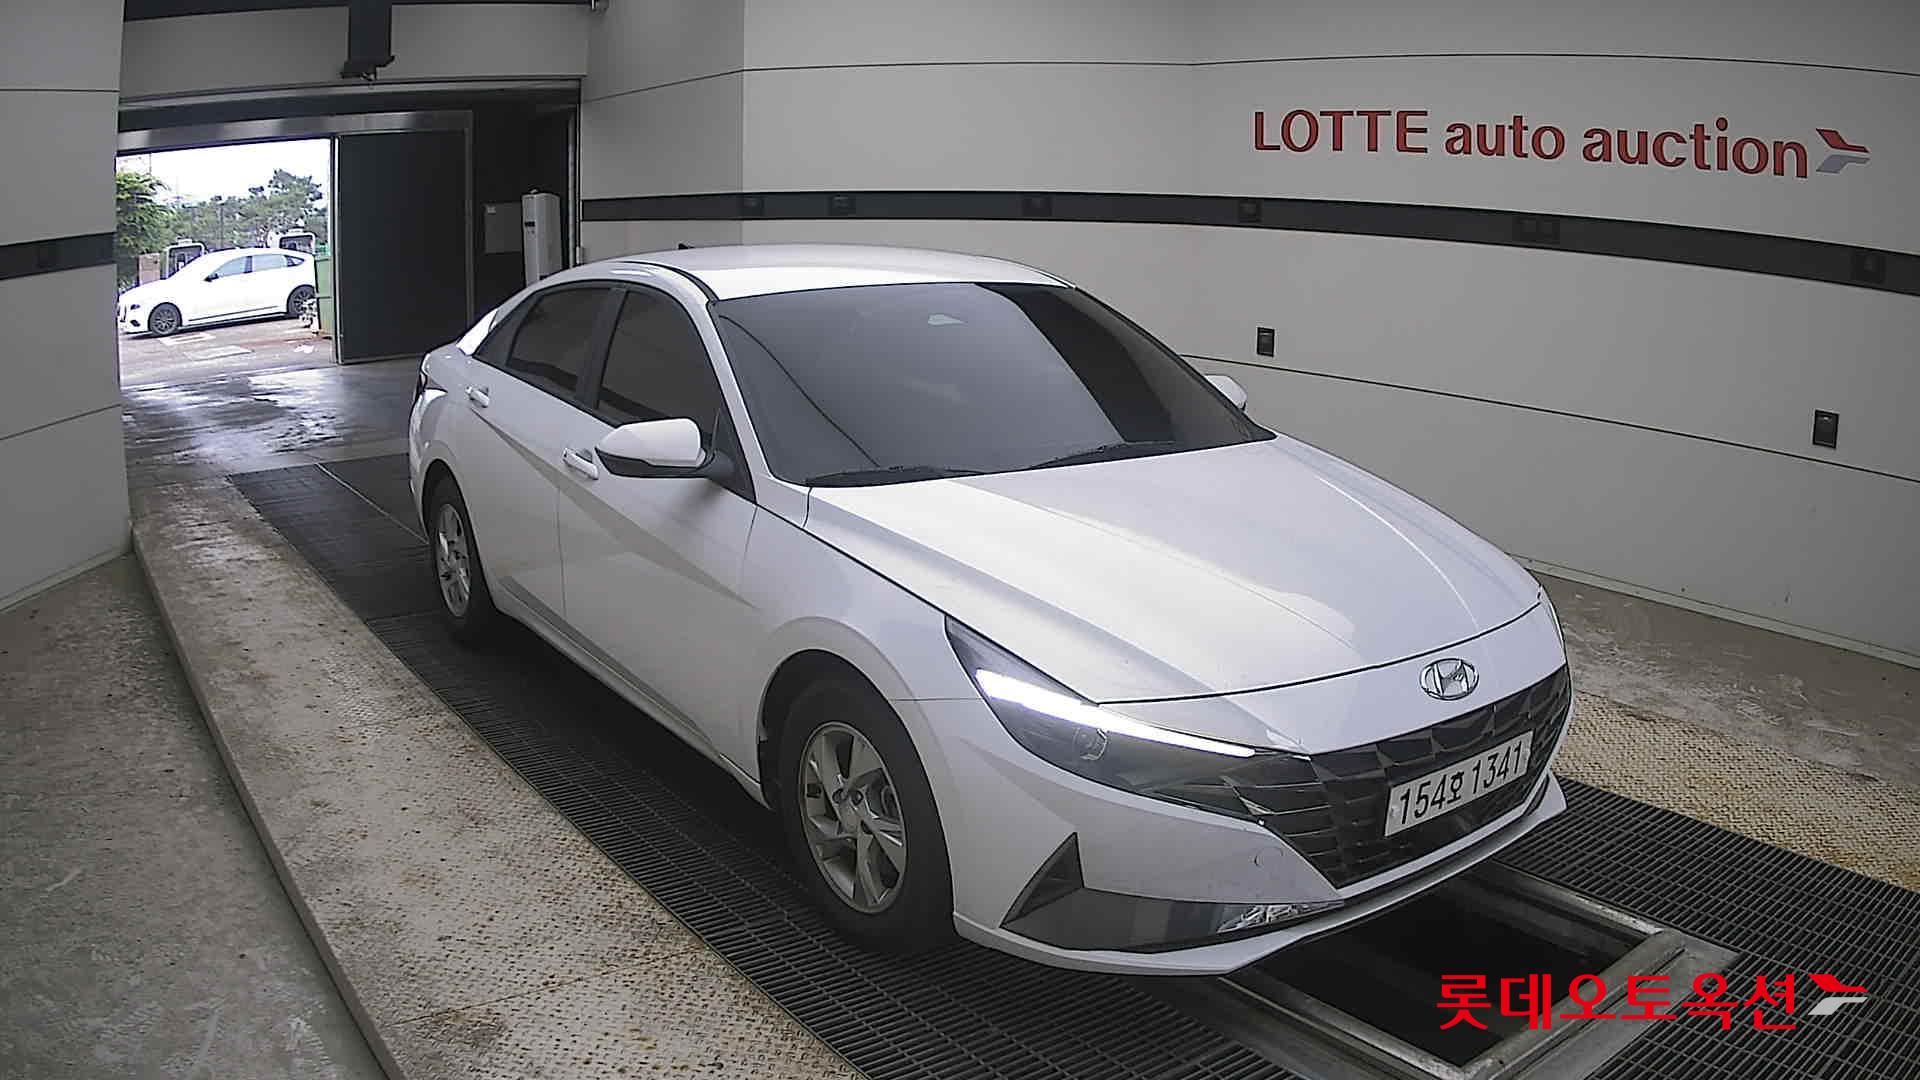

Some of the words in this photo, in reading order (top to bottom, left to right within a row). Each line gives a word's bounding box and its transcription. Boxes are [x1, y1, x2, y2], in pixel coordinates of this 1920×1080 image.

[1254, 110, 1428, 153] LOTTE
[1444, 115, 1567, 160] auto
[1581, 117, 1808, 179] auction
[1471, 740, 1523, 794] 1341
